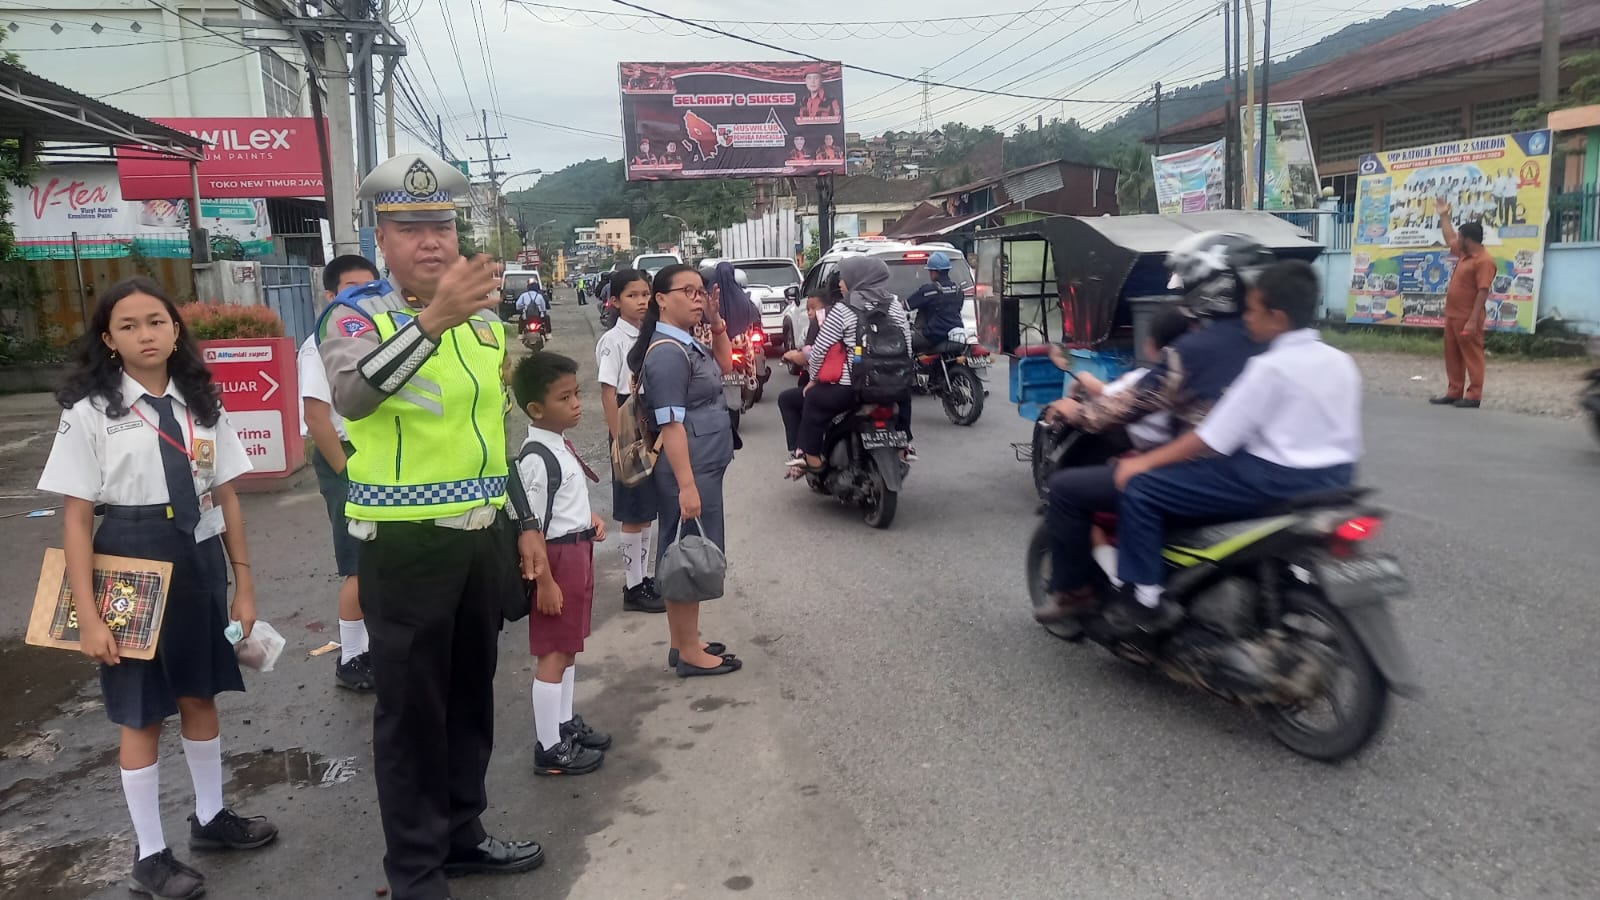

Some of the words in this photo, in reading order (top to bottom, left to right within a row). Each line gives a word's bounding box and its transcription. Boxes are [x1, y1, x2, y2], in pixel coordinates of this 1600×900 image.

[674, 95, 732, 105] SELAMAT
[736, 95, 745, 104] &
[748, 94, 795, 104] SUKSES
[142, 129, 291, 151] WILex
[1387, 151, 1401, 162] SMP
[1402, 148, 1432, 161] KATOLIK
[1434, 144, 1460, 156] FATIMA
[1463, 143, 1469, 152] 2
[1471, 138, 1506, 151] SARUDIK
[229, 152, 273, 161] PAINTS
[209, 180, 238, 189] TOKO
[240, 180, 264, 188] NEW
[266, 179, 297, 188] TIMUR
[298, 179, 324, 187] JAYA
[29, 177, 109, 220] V-tex
[217, 350, 247, 359] Alfamidi
[248, 350, 269, 358] super
[214, 381, 258, 393] LUAR
[237, 428, 271, 439] rima
[245, 443, 267, 456] sih
